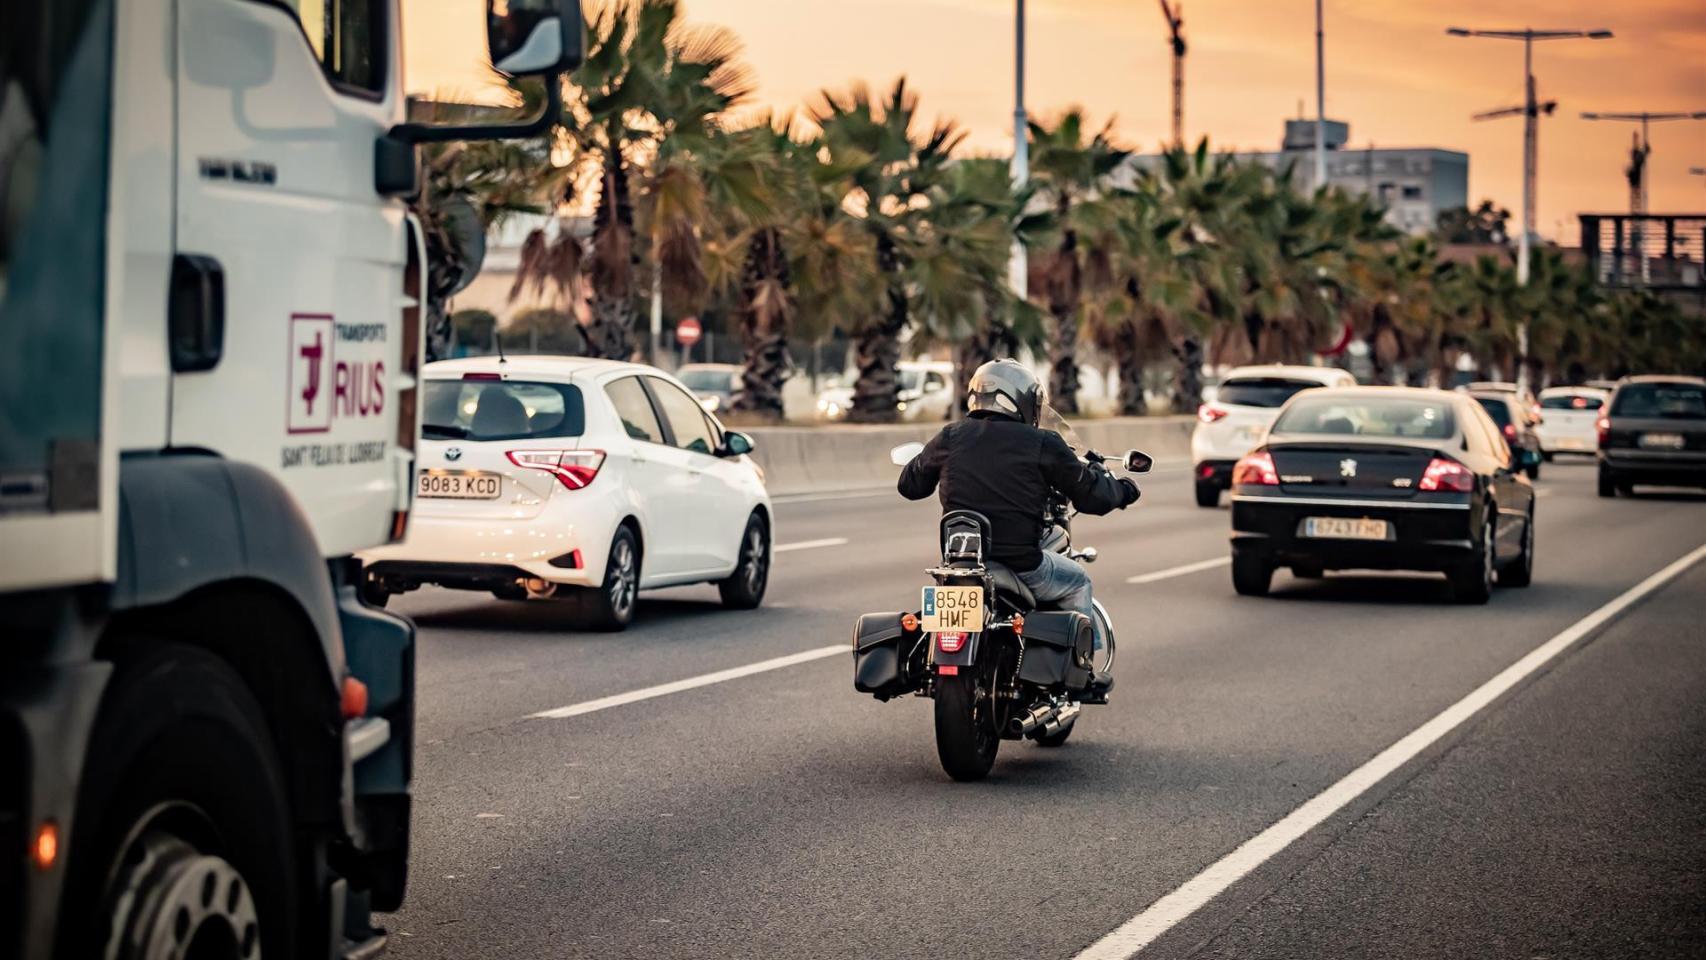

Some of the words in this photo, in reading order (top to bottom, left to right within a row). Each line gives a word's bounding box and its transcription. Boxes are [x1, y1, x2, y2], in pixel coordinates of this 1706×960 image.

[334, 361, 385, 417] RIUS
[421, 477, 460, 493] 9083
[466, 478, 496, 494] KCD
[936, 591, 978, 609] 8548
[939, 610, 971, 628] HMF
